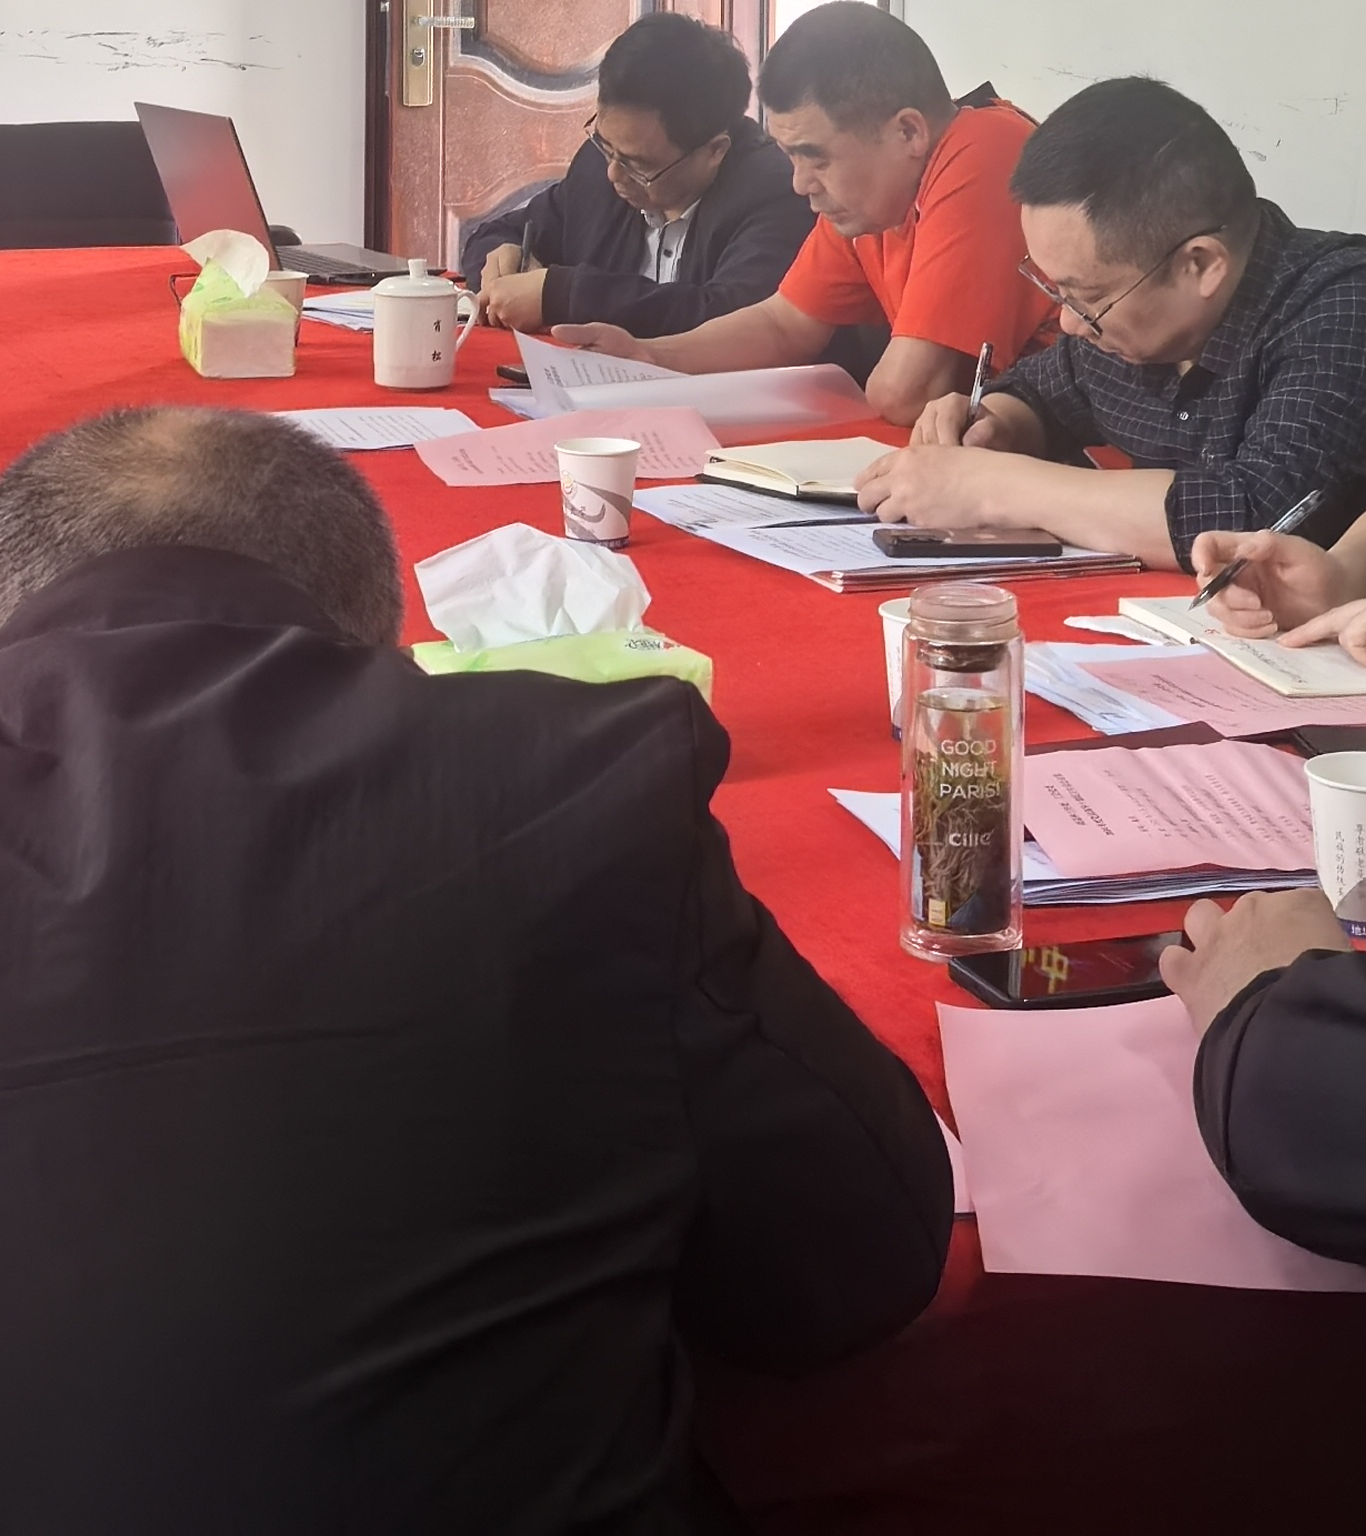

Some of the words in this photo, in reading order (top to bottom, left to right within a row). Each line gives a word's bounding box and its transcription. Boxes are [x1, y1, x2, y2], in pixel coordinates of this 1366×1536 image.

[941, 739, 997, 757] GOOD
[941, 760, 997, 778] NIGHT
[939, 781, 1000, 800] PARIS!
